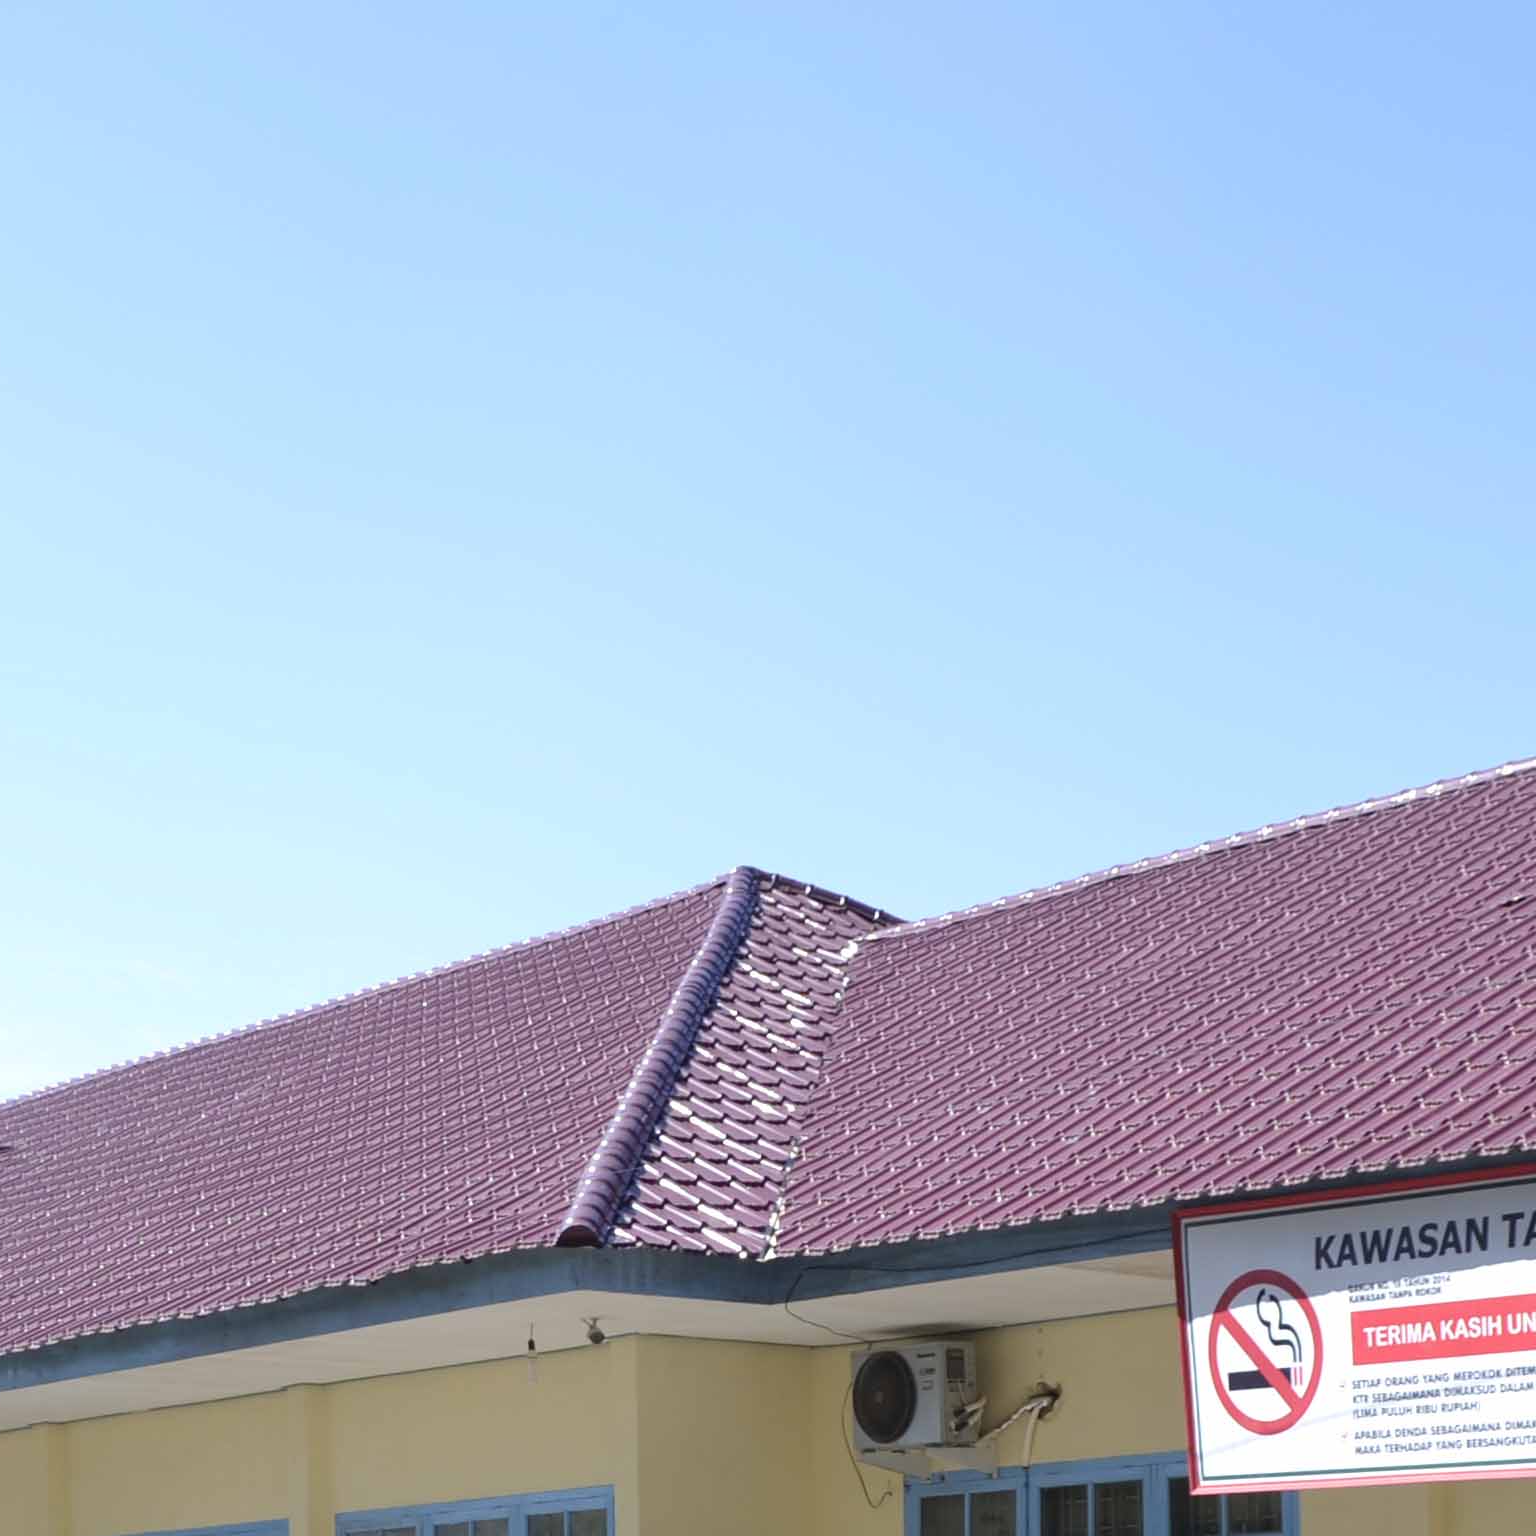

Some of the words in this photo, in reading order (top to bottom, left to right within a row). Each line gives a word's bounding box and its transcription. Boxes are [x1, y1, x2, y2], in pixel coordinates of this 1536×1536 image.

[1314, 1216, 1490, 1271] KAWASAN
[1363, 1321, 1436, 1349] TERIMA
[1440, 1315, 1503, 1340] KASIH
[1384, 1375, 1419, 1387] ORANG
[1423, 1373, 1449, 1384] YANG
[1453, 1368, 1503, 1382] MEROKOK
[1372, 1389, 1441, 1403] SEBAGAIMANA
[1444, 1384, 1497, 1397] DIMAKSUD
[1499, 1381, 1534, 1393] DALAM
[1381, 1406, 1412, 1417] PULUH
[1415, 1403, 1438, 1414] RIBU
[1354, 1429, 1391, 1441] APABILA
[1394, 1427, 1426, 1438] DENDA
[1430, 1421, 1501, 1435] SEBAGAIMANA
[1355, 1444, 1381, 1455] MAKA
[1385, 1441, 1433, 1454] TERHADAP
[1435, 1439, 1463, 1450] YANG
